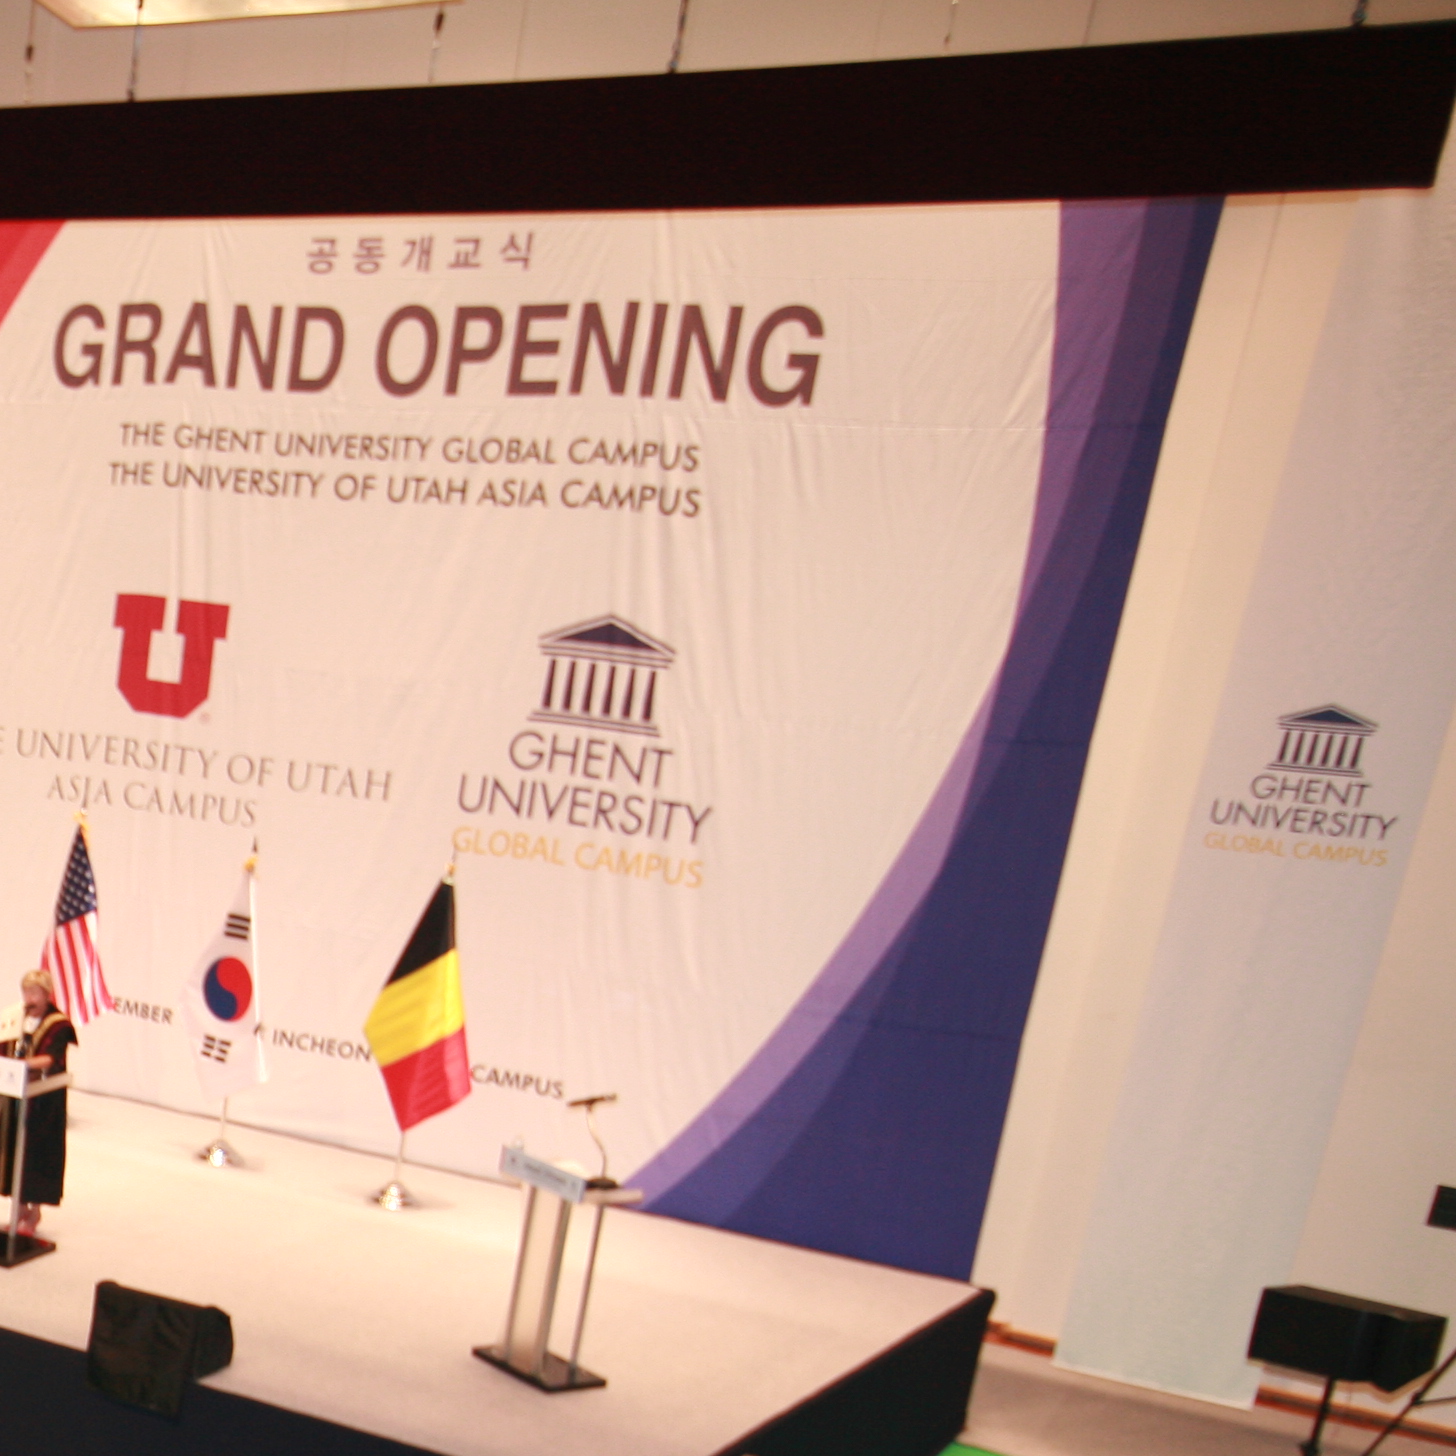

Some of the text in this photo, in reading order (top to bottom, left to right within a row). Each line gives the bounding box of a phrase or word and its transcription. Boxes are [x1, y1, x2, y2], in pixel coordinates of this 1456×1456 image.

[306, 232, 534, 275] 공동개교식
[53, 301, 825, 408] GRAND OPENING
[120, 422, 700, 473] THE GHENT UNIVERSITY GLOBAL CAMPUS
[109, 461, 702, 518] THE UNIVERSITY OF UTAH ASIA CAMPUS
[113, 592, 231, 720] U
[15, 728, 219, 780] UNIVERSITY
[226, 754, 276, 788] OF
[286, 761, 393, 802] UTAH
[508, 730, 674, 788] GHENT
[47, 774, 258, 828] ASIA CAMPUS
[458, 774, 713, 845] UNIVERSITY
[1250, 773, 1372, 807] GHENT
[1209, 798, 1399, 841] UNIVERSITY
[452, 826, 705, 889] GLOBAL CAMPUS
[1203, 831, 1389, 868] GLOBAL CAMPUS
[113, 997, 174, 1025] EMBER
[272, 1028, 371, 1063] INCHEON
[471, 1063, 563, 1099] CAMPUS
